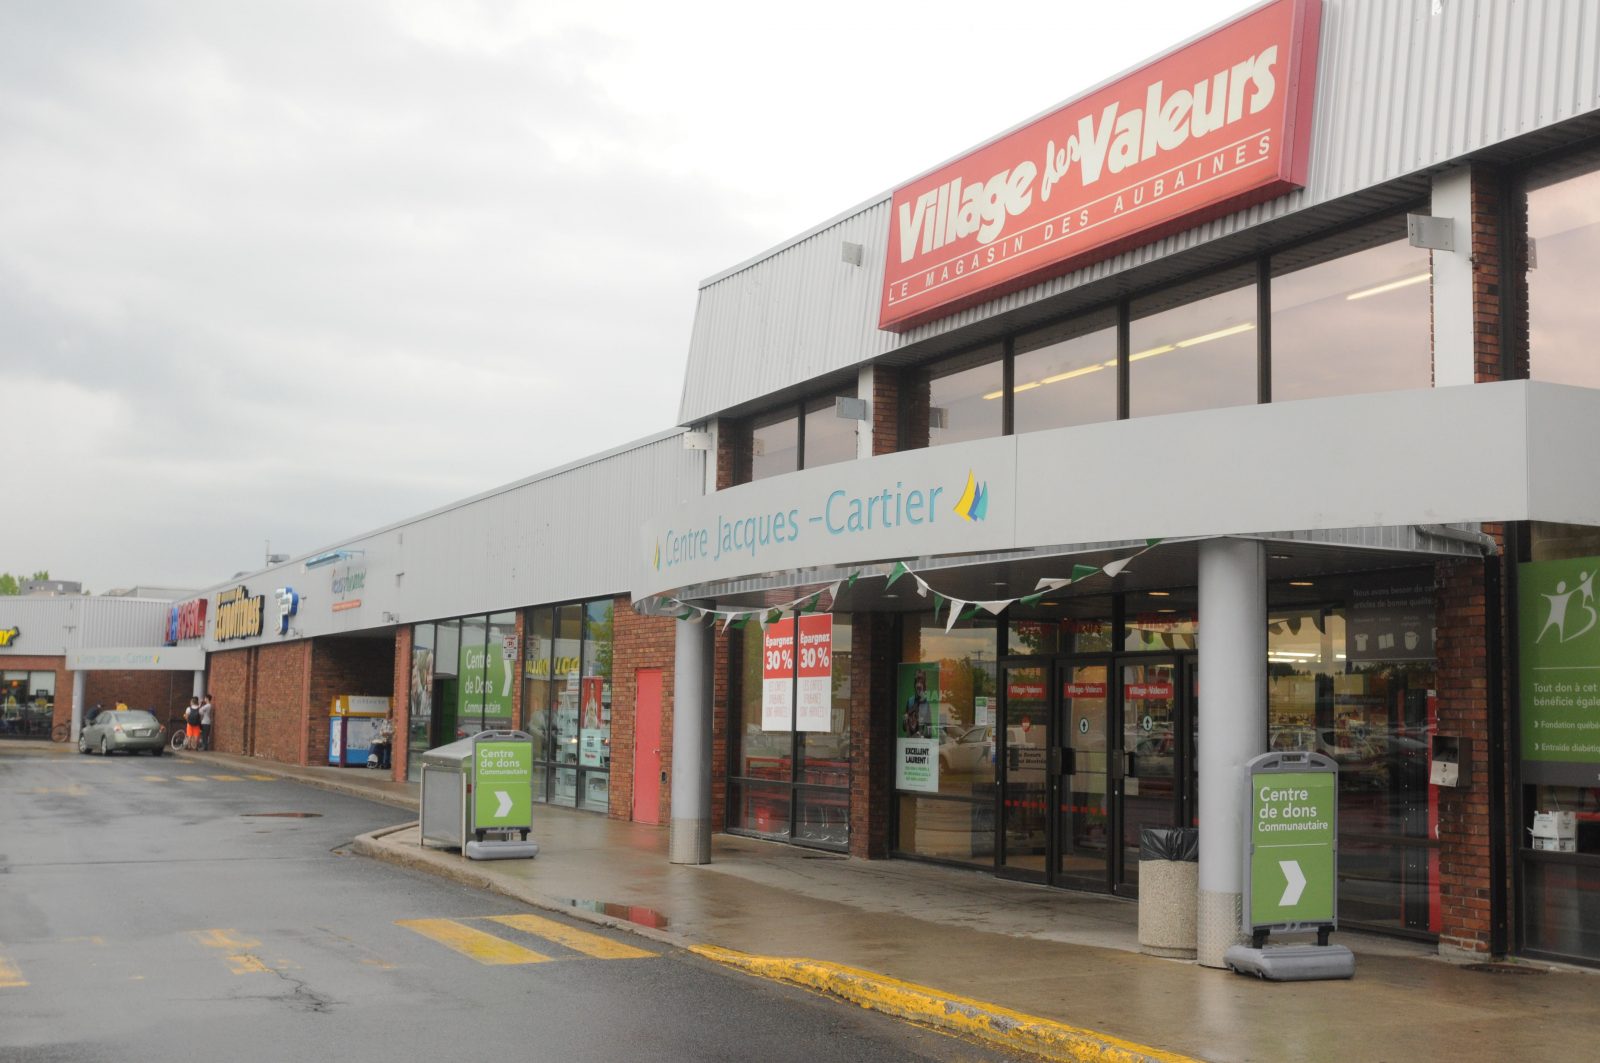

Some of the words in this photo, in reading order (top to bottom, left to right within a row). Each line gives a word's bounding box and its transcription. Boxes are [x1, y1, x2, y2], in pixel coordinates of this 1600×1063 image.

[899, 160, 1038, 263] Village
[1077, 45, 1279, 187] Valeurs
[888, 282, 909, 302] LE
[926, 236, 1024, 287] MAGASIN
[1044, 209, 1090, 241] DES
[1113, 135, 1271, 213] AUBAINES
[665, 527, 708, 567] Centre
[713, 507, 800, 561] Jacques
[766, 634, 793, 648] Épargnez
[800, 631, 830, 645] Épargnez
[465, 675, 474, 694] de
[1533, 683, 1552, 692] Tout
[1555, 682, 1573, 692] don
[1583, 683, 1597, 692] cet
[1534, 696, 1574, 706] bénéficie
[1541, 720, 1576, 729] Fondation
[481, 749, 514, 758] Centre
[905, 747, 929, 756] EXCELLENT
[1541, 743, 1570, 752] Entraide
[481, 759, 494, 768] de
[496, 758, 520, 768] dons
[1260, 786, 1308, 802] Centre
[1259, 802, 1277, 819] de
[1282, 802, 1317, 818] dons
[1258, 819, 1328, 832] Communautaire
